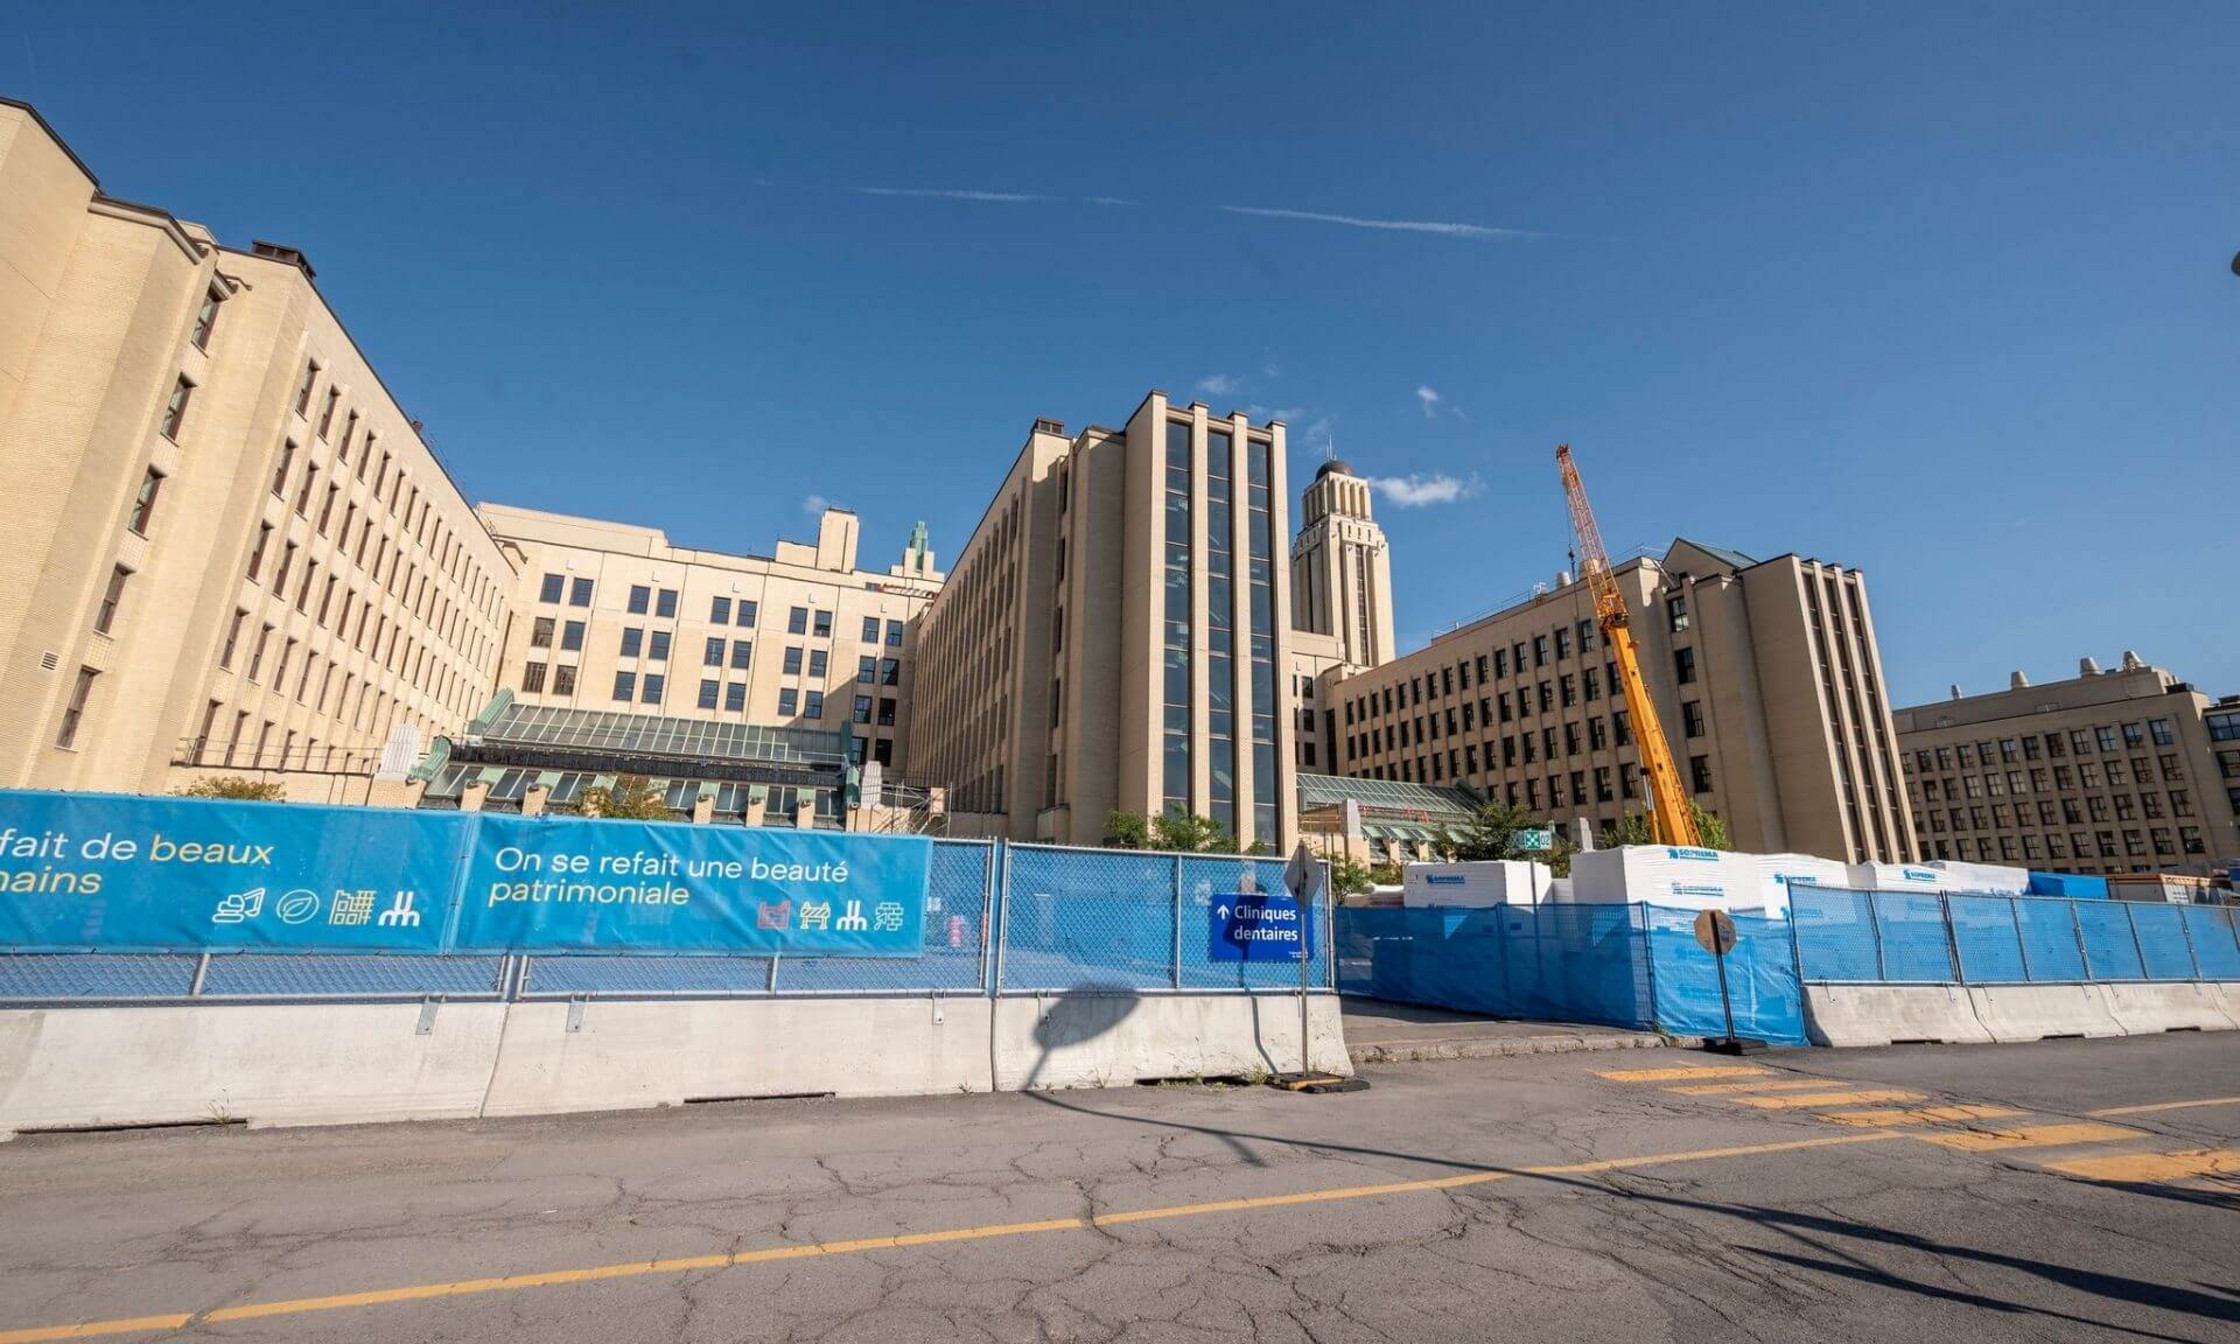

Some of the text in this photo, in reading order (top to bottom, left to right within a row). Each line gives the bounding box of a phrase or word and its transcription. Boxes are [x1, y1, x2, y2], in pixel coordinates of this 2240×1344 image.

[81, 832, 138, 861] de
[149, 833, 275, 865] beaux
[0, 865, 102, 894] ains
[495, 847, 849, 883] On se refait une beauté
[488, 878, 690, 907] patrimoniale
[1234, 905, 1296, 923] Cliniques
[1234, 925, 1298, 941] dentaires
